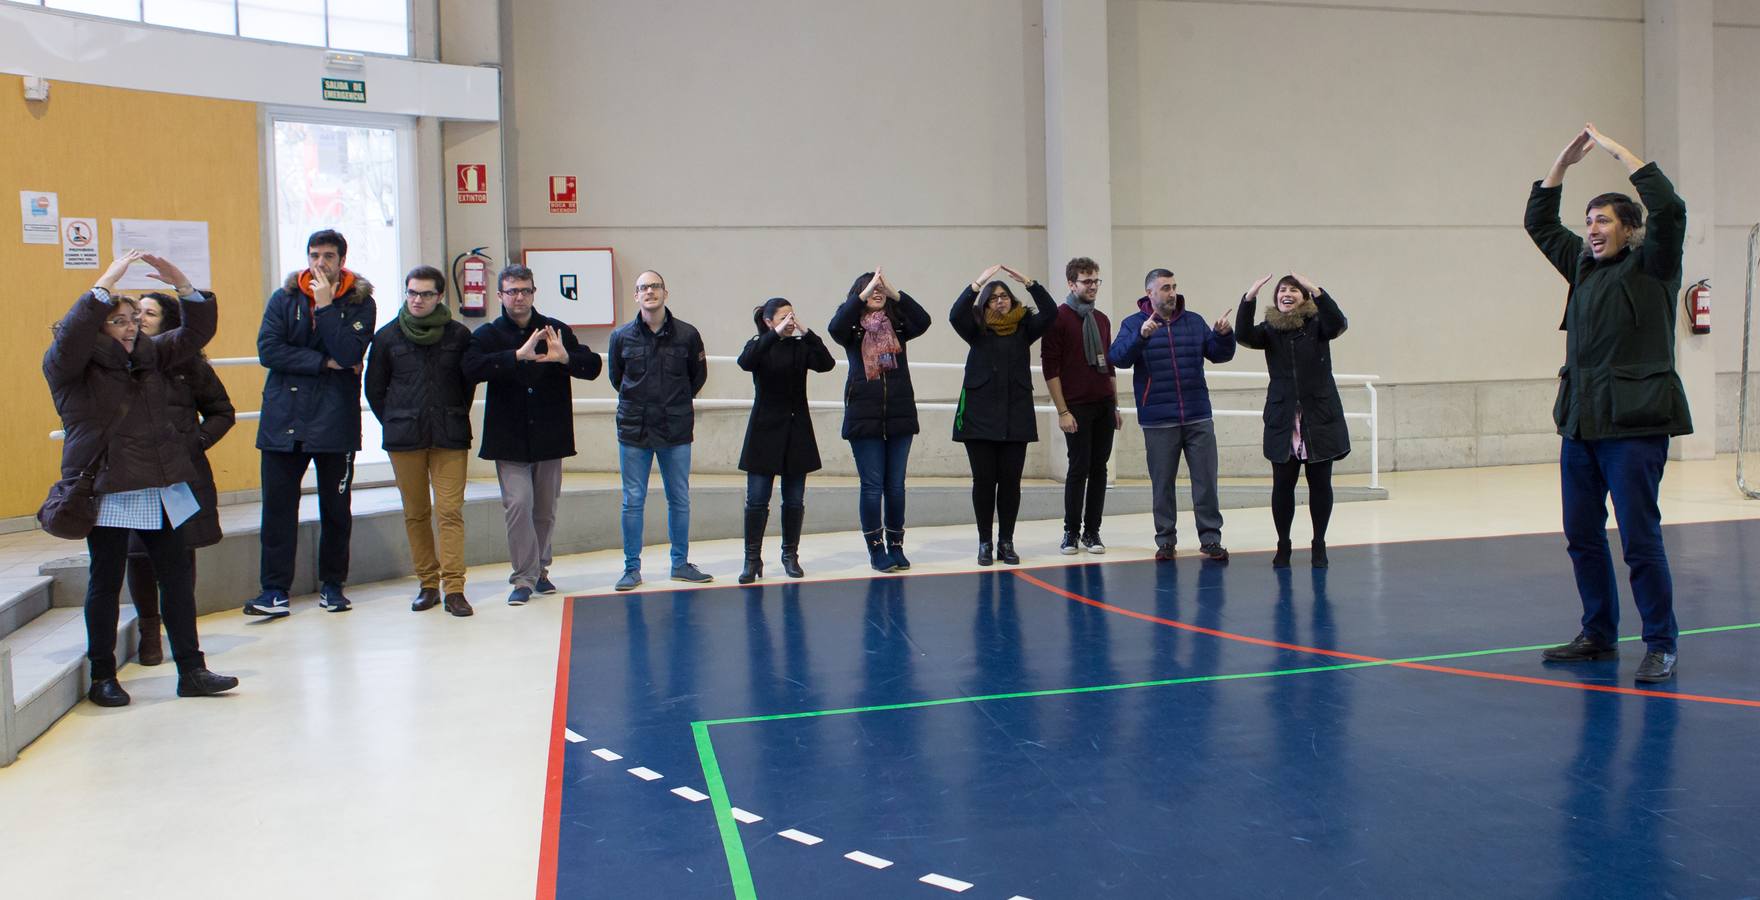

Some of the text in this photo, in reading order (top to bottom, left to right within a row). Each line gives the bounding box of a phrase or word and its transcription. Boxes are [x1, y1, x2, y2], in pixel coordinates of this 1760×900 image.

[324, 80, 363, 92] SALIDA DE
[324, 90, 364, 101] EMERGENCIA
[458, 194, 487, 202] EXTINTOR
